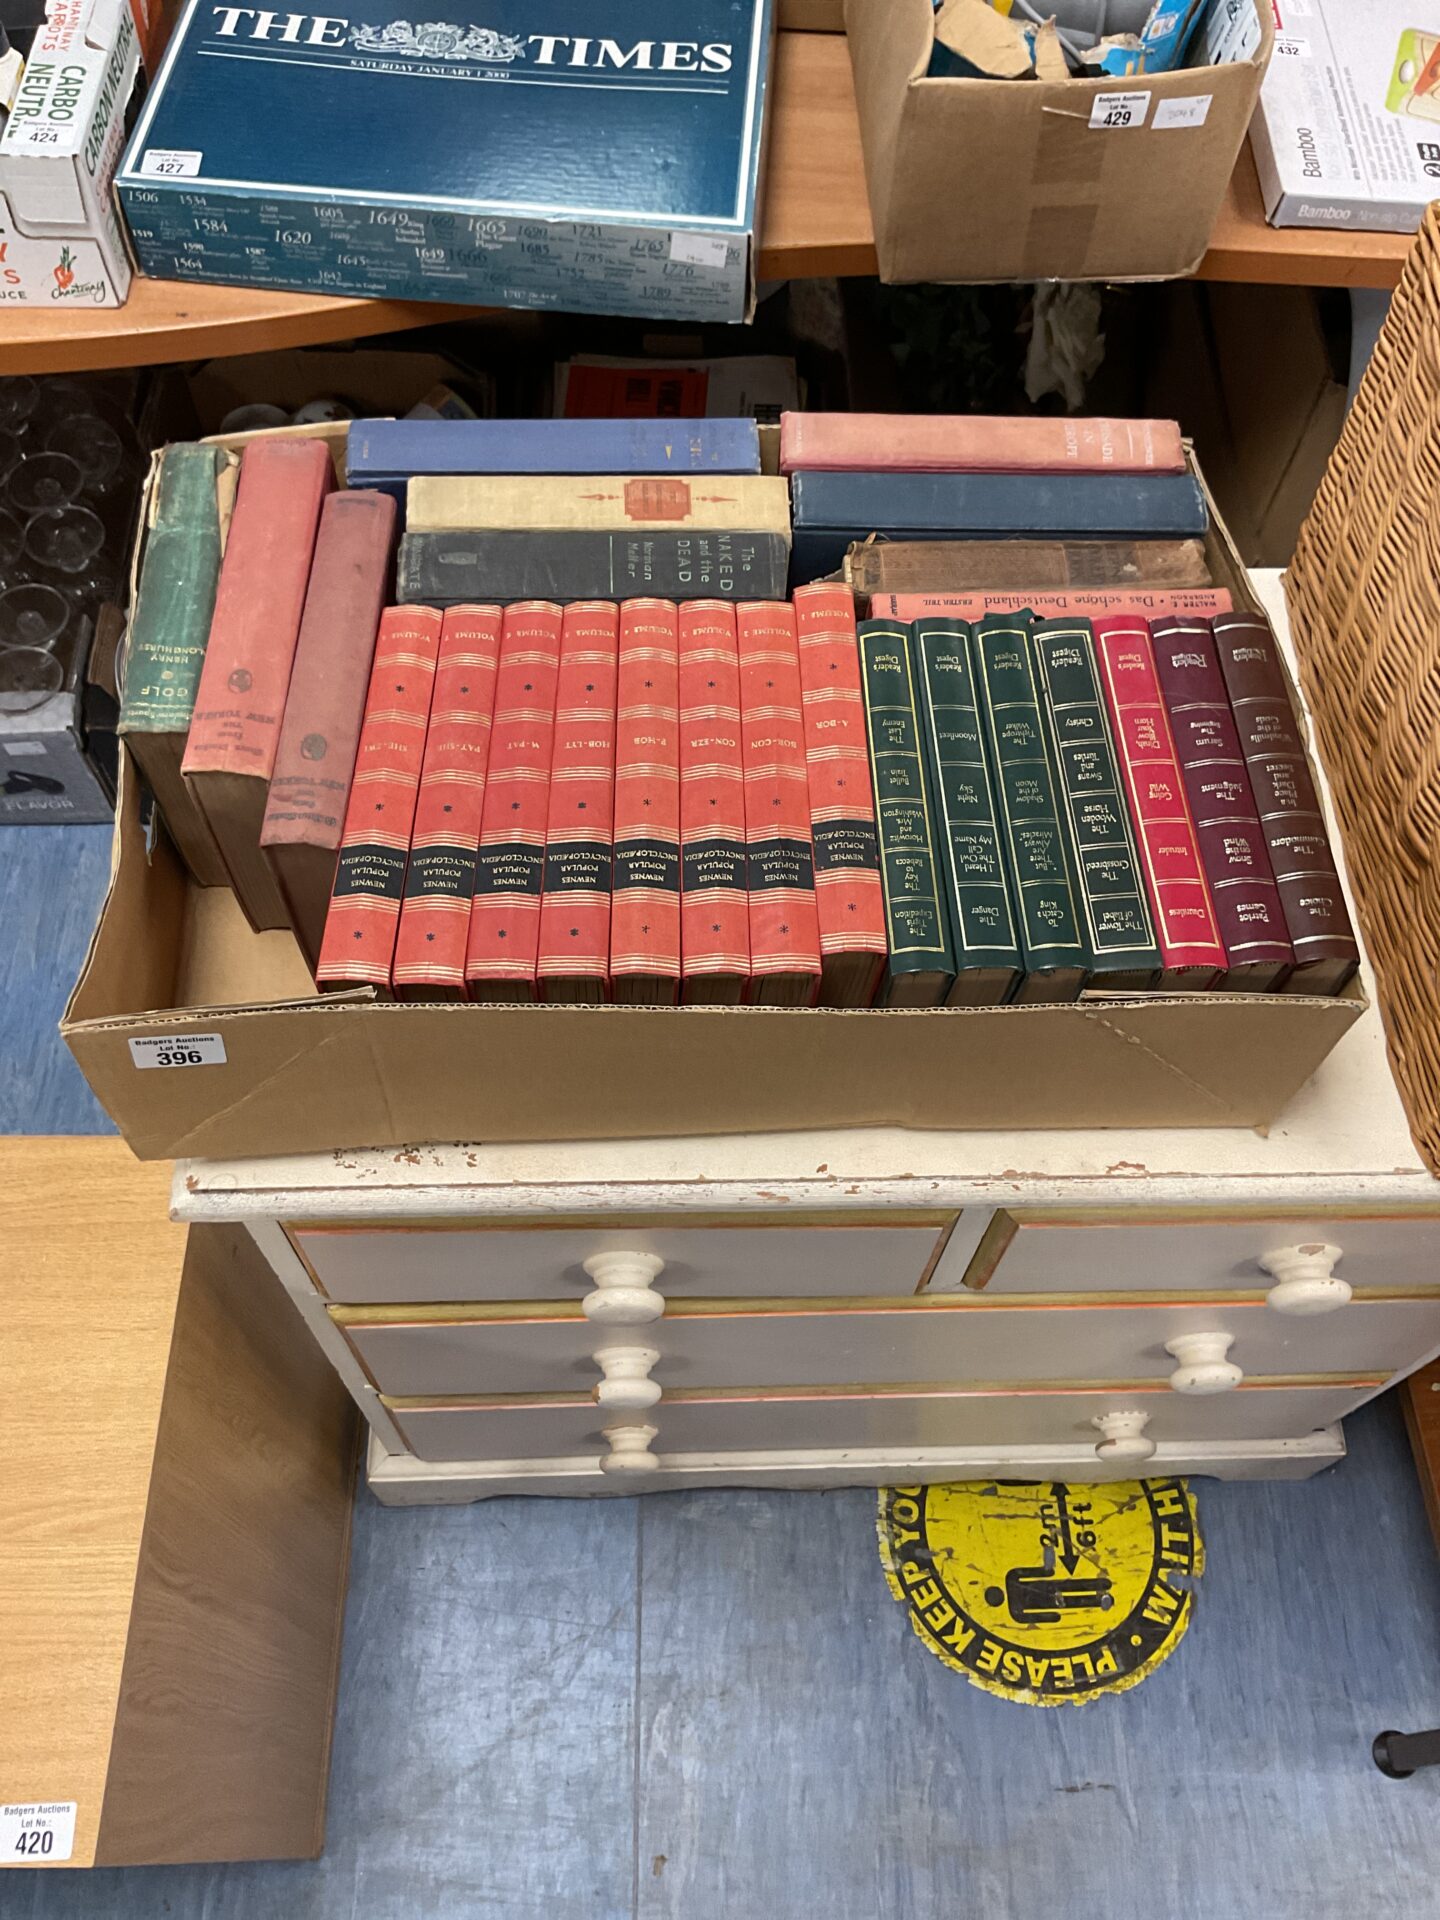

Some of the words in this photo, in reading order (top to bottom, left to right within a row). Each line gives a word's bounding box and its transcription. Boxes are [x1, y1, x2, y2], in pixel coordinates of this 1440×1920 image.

[212, 6, 349, 49] THE
[528, 35, 732, 72] TIMES
[1277, 46, 1300, 56] 432
[350, 59, 413, 72] SATURDAY
[417, 66, 472, 77] JANUARY
[485, 71, 510, 79] 2000
[48, 66, 86, 120] CARBO
[85, 82, 113, 176] CARBON
[107, 5, 134, 99] NEUTRAL
[1103, 111, 1132, 126] 429
[29, 132, 58, 143] 424
[1296, 127, 1322, 178] Bamboo
[156, 163, 184, 173] 427
[129, 190, 158, 203] 1506
[180, 194, 207, 206] 1534
[313, 206, 344, 218] 1605
[1298, 204, 1351, 220] Bamboo
[369, 210, 409, 226] 1649
[194, 218, 228, 232] 1584
[468, 219, 506, 234] 1665
[274, 230, 311, 245] 1620
[415, 248, 445, 260] 1649
[174, 257, 202, 269] 1564
[677, 540, 692, 582] DEAD
[717, 535, 733, 591] NAKED
[741, 547, 755, 572] The
[700, 560, 714, 583] the
[983, 596, 1067, 608] Deutschland
[1074, 593, 1122, 607] schöne
[1128, 595, 1154, 607] Das
[138, 643, 204, 655] LONGHURST
[1051, 648, 1080, 658] Digest
[150, 654, 188, 664] HENRY
[874, 654, 899, 663] Digest
[936, 654, 959, 664] Digest
[994, 652, 1019, 662] Digest
[1118, 654, 1141, 663] Digest
[873, 662, 901, 673] Reader's
[934, 663, 962, 672] Reader's
[993, 661, 1022, 670] Reader's
[1050, 657, 1083, 668] Reader's
[141, 685, 188, 697] GOLF
[815, 719, 849, 729] A-BOR
[882, 719, 906, 728] Enemy
[1005, 722, 1030, 730] Walker
[1065, 717, 1093, 728] Christy
[939, 732, 977, 741] Moonfleet
[1002, 728, 1036, 738] Tightrope
[889, 735, 903, 743] The
[1013, 737, 1028, 745] The
[1195, 738, 1223, 747] Sarum
[1073, 752, 1100, 762] Turtles
[1080, 762, 1095, 771] and
[889, 776, 909, 785] Bullet
[1077, 771, 1103, 781] Swans
[958, 783, 974, 793] Sky
[1015, 779, 1038, 788] Moon
[1149, 783, 1171, 791] Wild
[1200, 782, 1242, 793] Judgment
[1272, 781, 1295, 790] Dark
[957, 793, 978, 803] Night
[1015, 794, 1044, 803] Shadow
[1148, 790, 1172, 801] Going
[1216, 791, 1235, 801] The
[883, 808, 923, 819] Washington
[1083, 804, 1109, 814] Horse
[1080, 813, 1116, 824] Wooden
[899, 826, 912, 834] and
[1091, 824, 1109, 834] The
[890, 834, 923, 843] Horowitz
[954, 835, 975, 844] Name
[977, 835, 992, 844] My
[1024, 838, 1050, 848] Always
[1222, 837, 1249, 847] Wind
[1271, 836, 1325, 848] Commodore
[827, 841, 865, 851] POPULAR
[968, 845, 983, 854] Call
[1157, 846, 1188, 856] Intruder
[1293, 845, 1314, 855] The
[829, 853, 864, 862] NEWNES
[895, 858, 923, 867] Rebecca
[959, 854, 977, 863] Owl
[979, 854, 994, 863] The
[1029, 854, 1052, 863] There
[1228, 855, 1253, 865] Snow
[492, 866, 531, 874] POPULAR
[560, 864, 599, 873] POPULAR
[628, 861, 667, 871] POPULAR
[697, 860, 735, 871] POPULAR
[761, 861, 800, 871] POPULAR
[964, 863, 986, 872] Heard
[1086, 859, 1129, 872] Crossbreed
[351, 867, 390, 877] POPULAR
[422, 868, 462, 877] POPULAR
[1101, 871, 1119, 880] The
[493, 878, 528, 886] NEWNES
[561, 875, 596, 884] NEWNES
[629, 873, 665, 882] NEWNES
[698, 872, 733, 883] NEWNES
[764, 873, 798, 882] NEWNES
[350, 879, 386, 889] NEWNES
[422, 880, 458, 889] NEWNES
[904, 882, 921, 891] The
[1039, 900, 1057, 910] King
[1299, 897, 1333, 907] Choice
[971, 905, 999, 916] Danger
[1168, 908, 1205, 918] Dauntless
[1236, 903, 1266, 913] Games
[1309, 907, 1331, 917] The
[894, 910, 933, 920] Expedition
[1102, 911, 1123, 922] Babel
[1239, 912, 1269, 922] Patriot
[979, 916, 996, 925] The
[909, 926, 925, 936] The
[1098, 922, 1125, 932] Tower
[1125, 921, 1142, 931] The
[156, 1051, 203, 1065] 396
[1039, 1503, 1060, 1549] 2m
[1073, 1501, 1097, 1549] 6ft
[902, 1559, 976, 1655] KEEP
[975, 1637, 1119, 1690] PLEASE
[4, 1807, 35, 1817] Badgers
[38, 1805, 70, 1814] Auctions
[21, 1819, 33, 1828] Lot
[15, 1830, 53, 1855] 420
